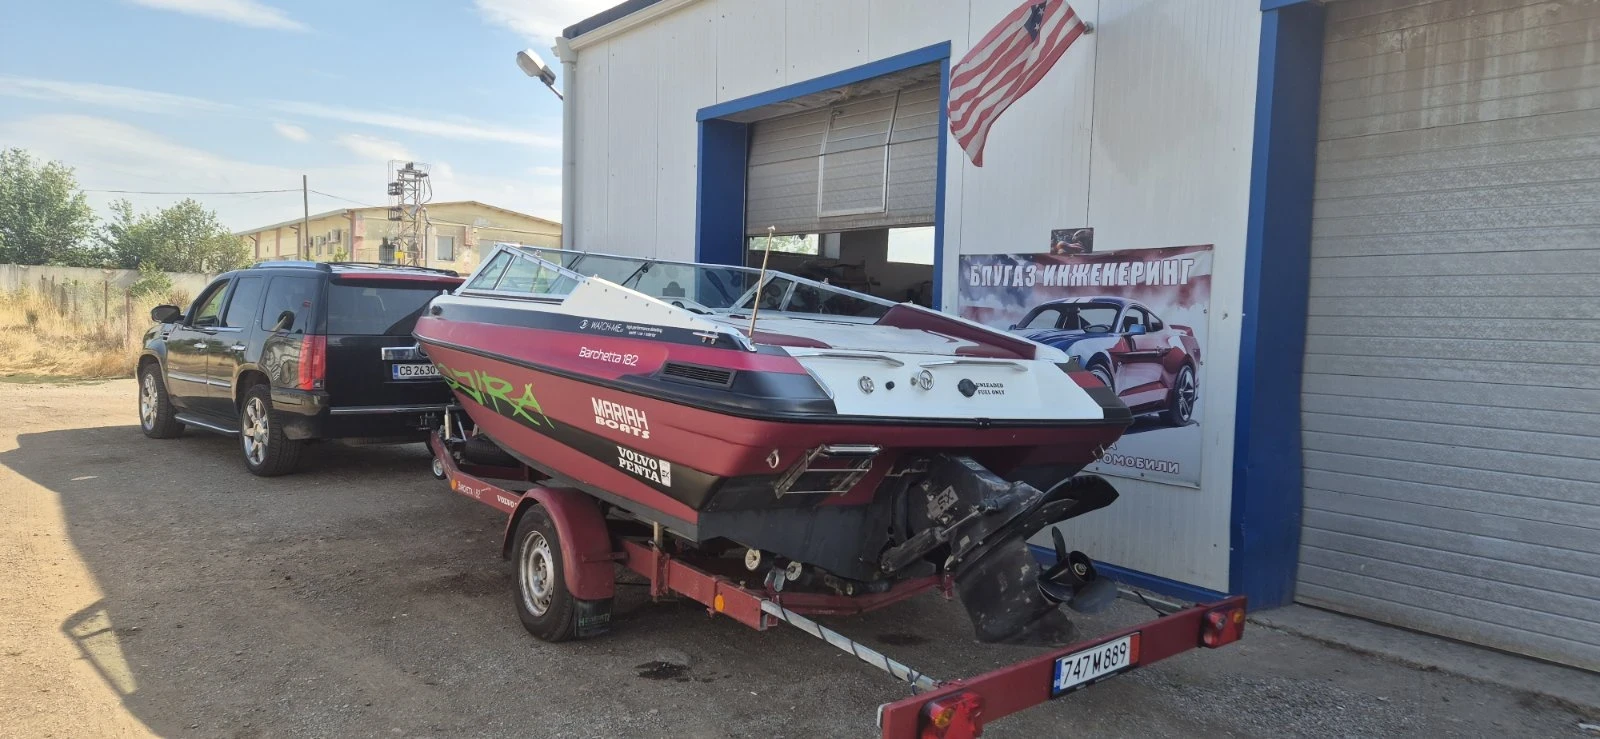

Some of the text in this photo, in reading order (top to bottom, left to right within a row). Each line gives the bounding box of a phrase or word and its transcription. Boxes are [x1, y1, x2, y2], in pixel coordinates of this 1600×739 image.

[1043, 259, 1194, 287] ИНЖЕНЕРИНГ
[578, 346, 639, 366] Barchetta 182
[413, 366, 436, 376] 2630
[592, 397, 649, 431] MARIAH
[595, 415, 650, 439] BOATS
[617, 446, 658, 470] VOLVO
[618, 456, 661, 484] PENTA
[1097, 453, 1180, 474] ОМОБИЛИ
[496, 494, 515, 508] VOLVO
